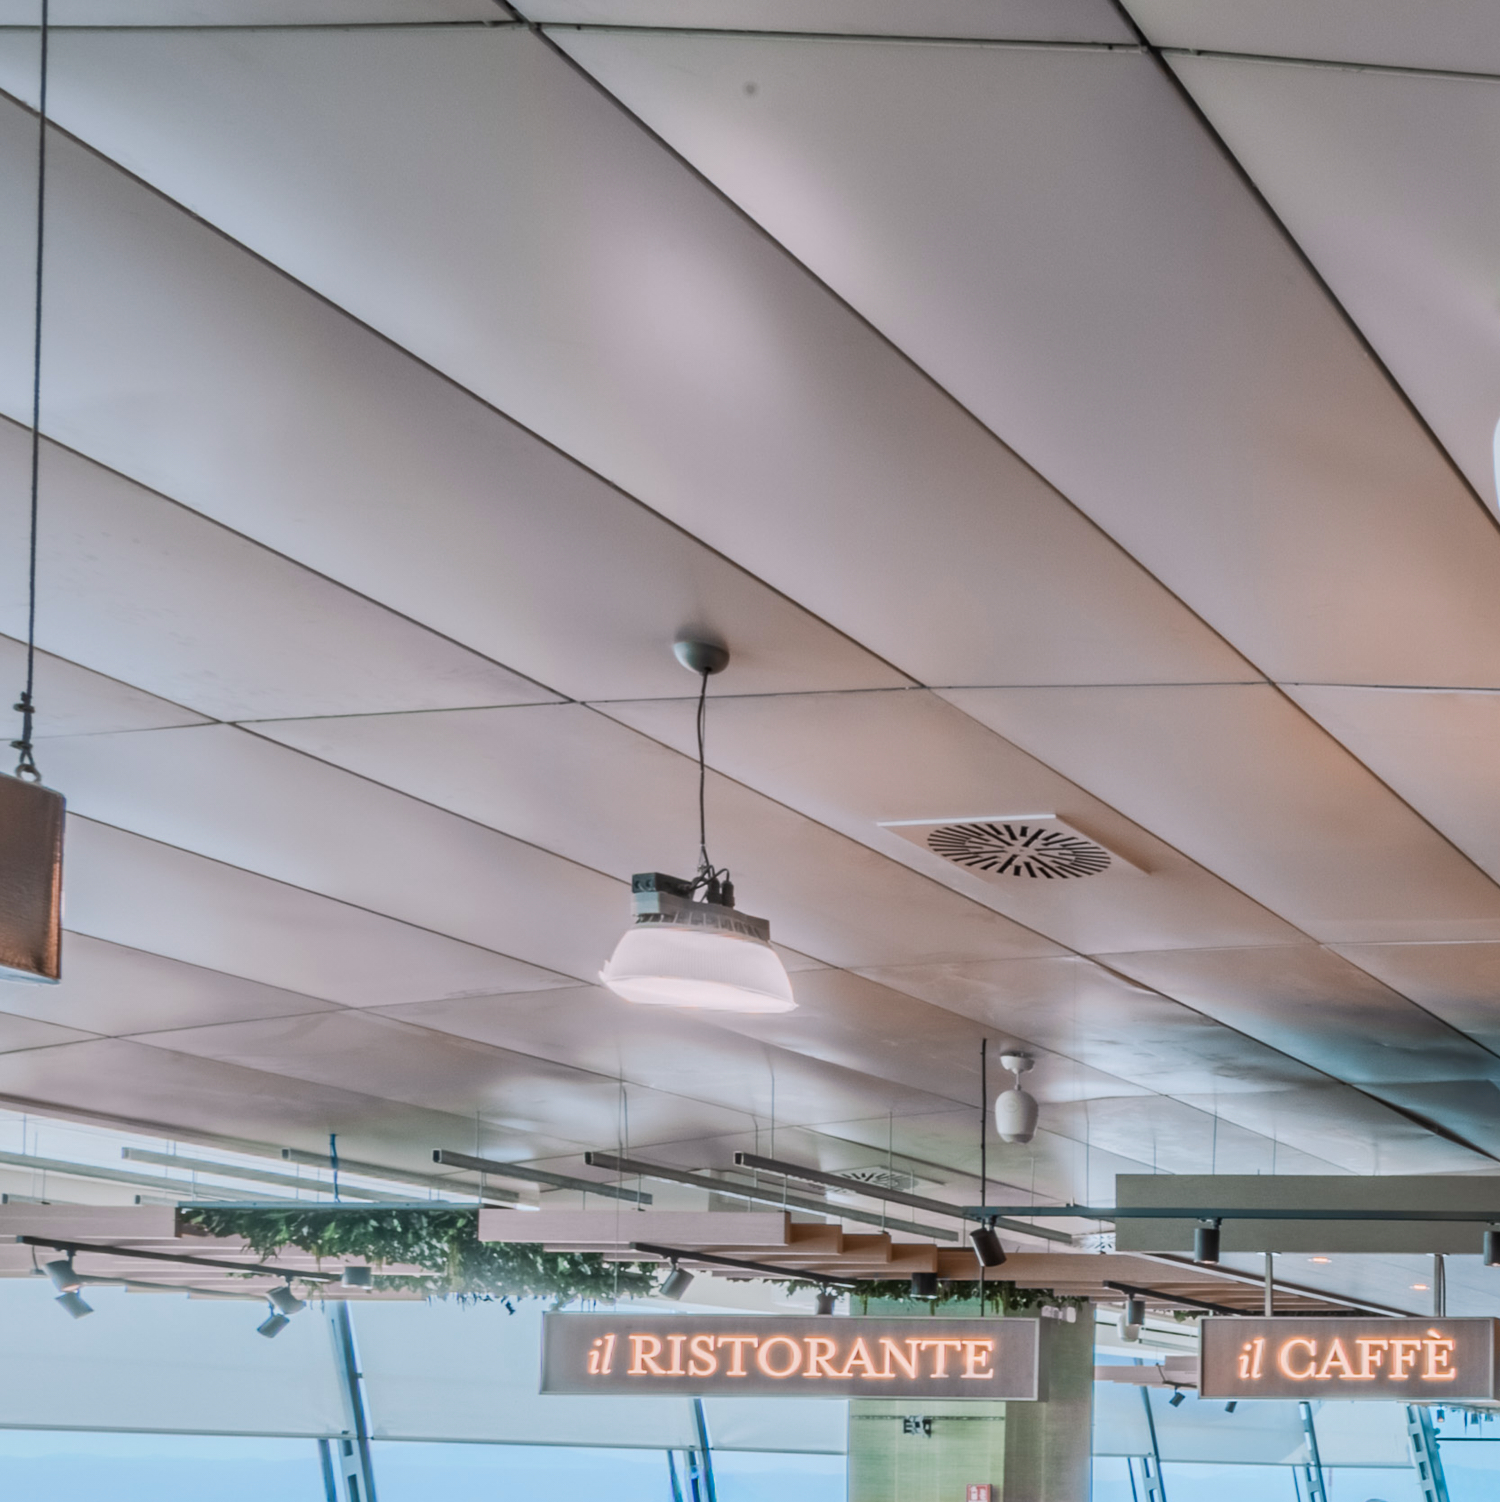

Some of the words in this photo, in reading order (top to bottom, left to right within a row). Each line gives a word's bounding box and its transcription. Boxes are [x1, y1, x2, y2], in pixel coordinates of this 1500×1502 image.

[588, 1334, 615, 1375] il
[627, 1333, 994, 1379] RISTORANTE
[1239, 1338, 1265, 1379] il
[1279, 1328, 1456, 1380] CAFFÈ
